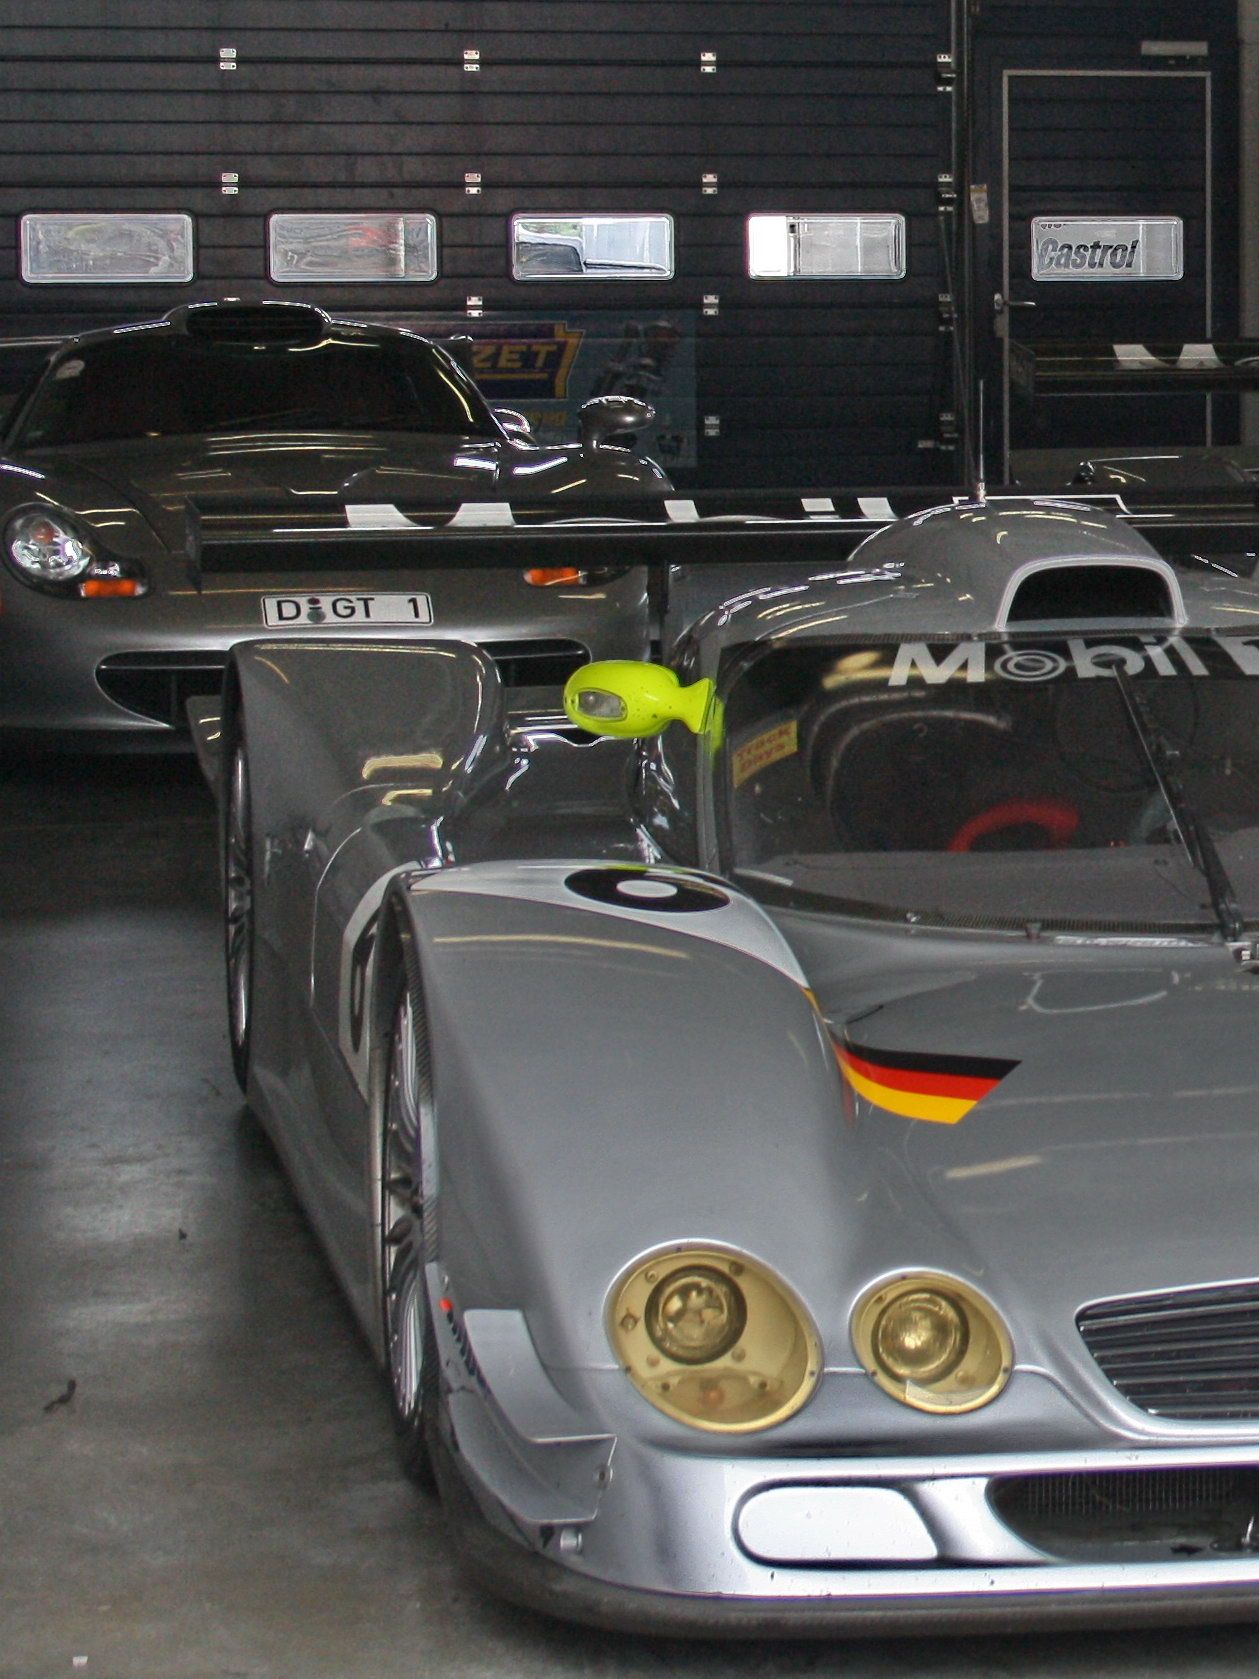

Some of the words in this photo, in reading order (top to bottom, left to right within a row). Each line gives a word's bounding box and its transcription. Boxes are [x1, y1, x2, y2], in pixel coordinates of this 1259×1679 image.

[1037, 237, 1140, 270] Castrol
[471, 343, 558, 369] ZET
[407, 597, 420, 619] 1
[887, 634, 1210, 687] Mobil
